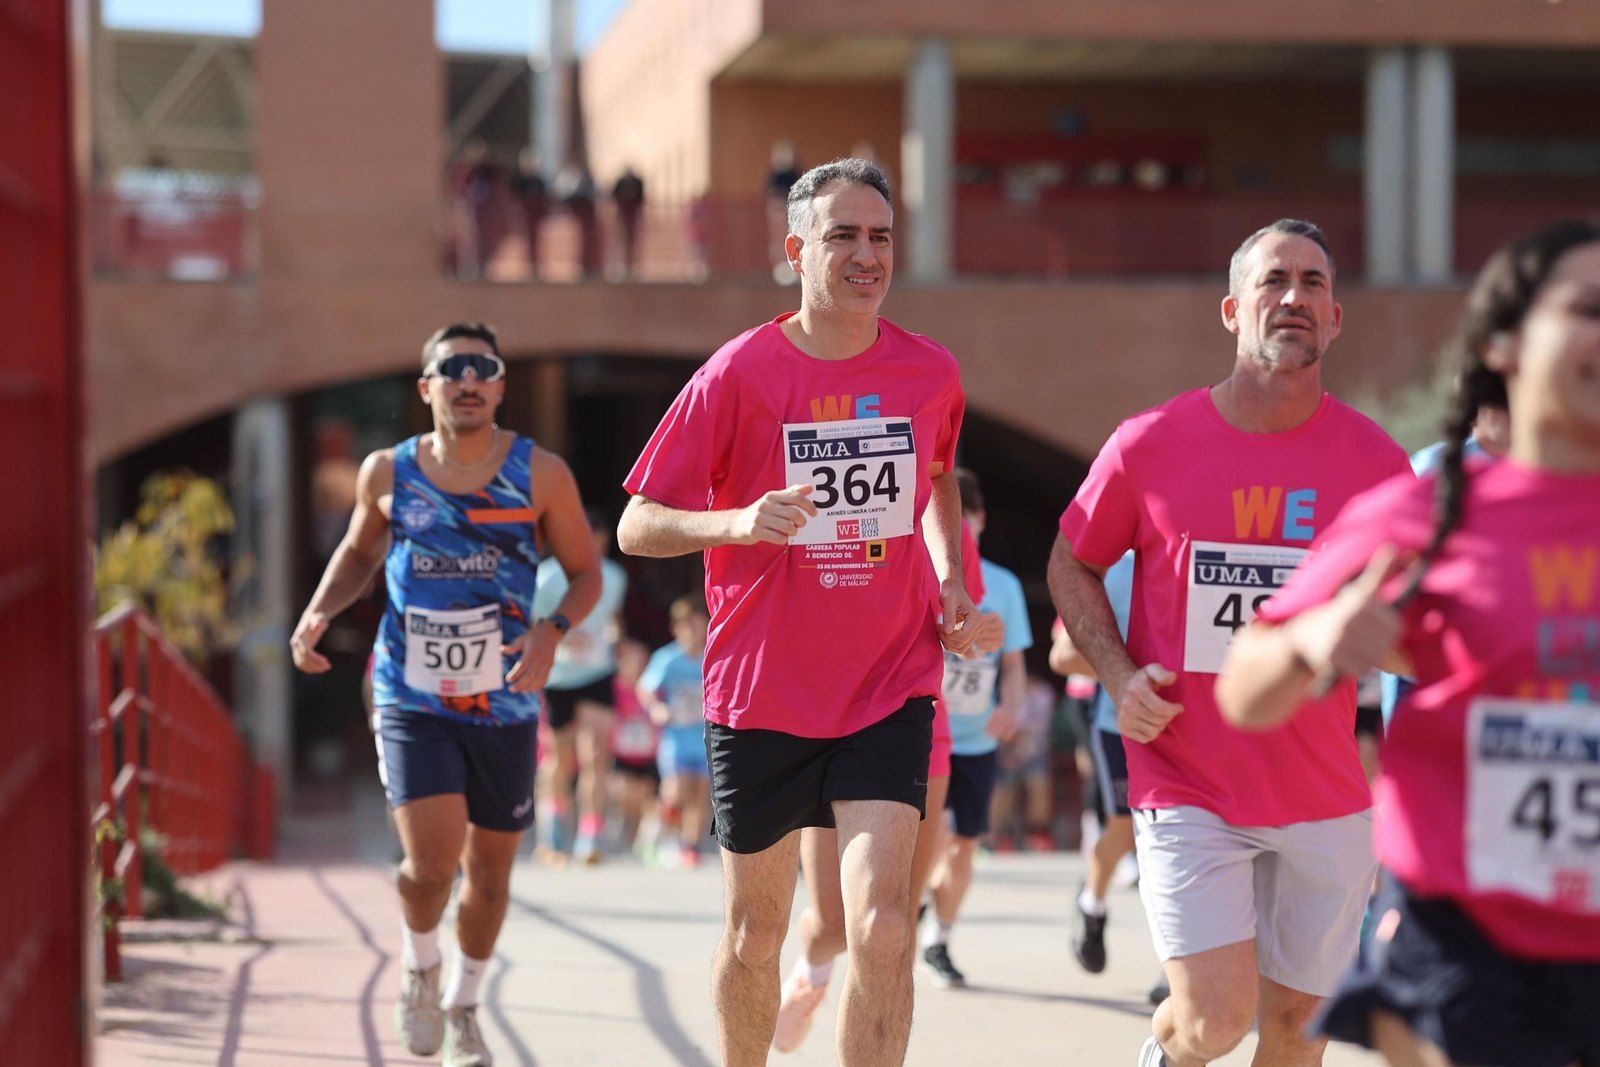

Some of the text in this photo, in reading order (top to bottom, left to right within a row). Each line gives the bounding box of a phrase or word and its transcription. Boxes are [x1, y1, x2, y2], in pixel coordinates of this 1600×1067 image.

[792, 442, 851, 459] UMA
[812, 461, 900, 508] 364
[1231, 486, 1316, 540] WE
[837, 524, 859, 535] WE
[1198, 565, 1263, 585] UMA
[424, 639, 487, 670] 507
